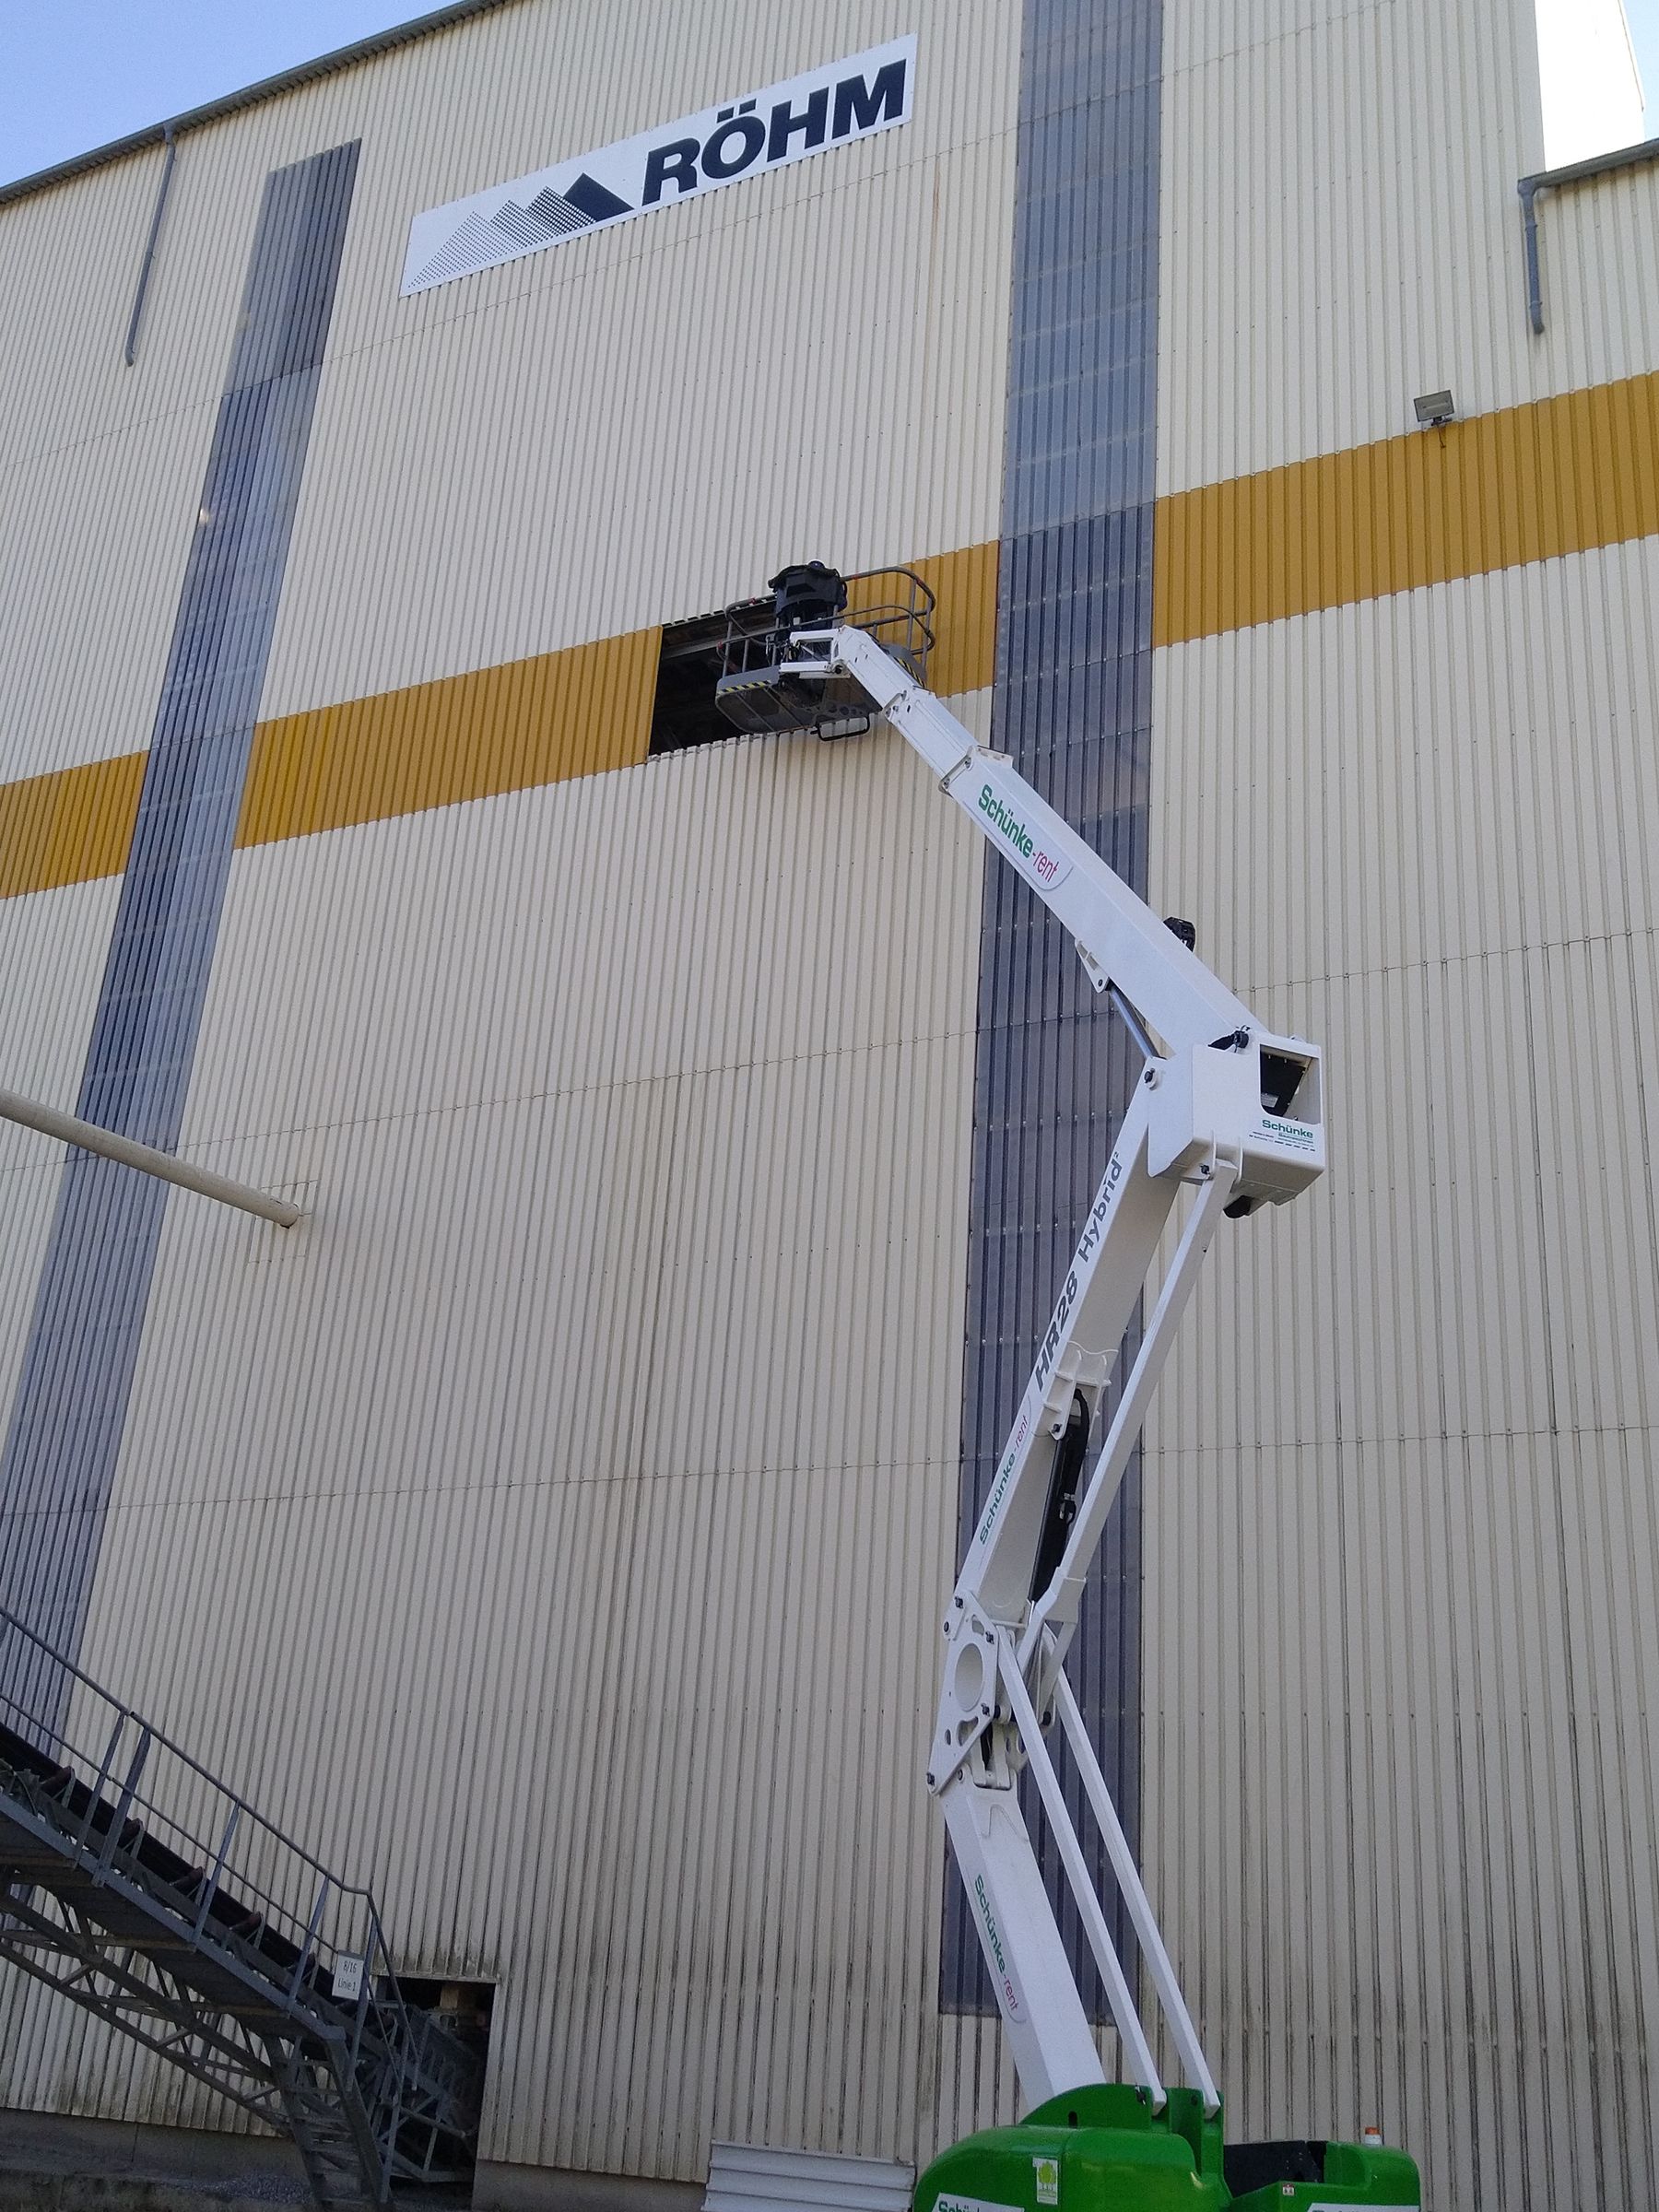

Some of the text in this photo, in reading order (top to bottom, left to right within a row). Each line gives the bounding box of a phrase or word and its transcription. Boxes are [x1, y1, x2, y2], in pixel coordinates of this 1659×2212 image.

[641, 58, 907, 206] RÖHM
[1262, 1119, 1313, 1138] Schünke
[1036, 1271, 1077, 1392] HR28
